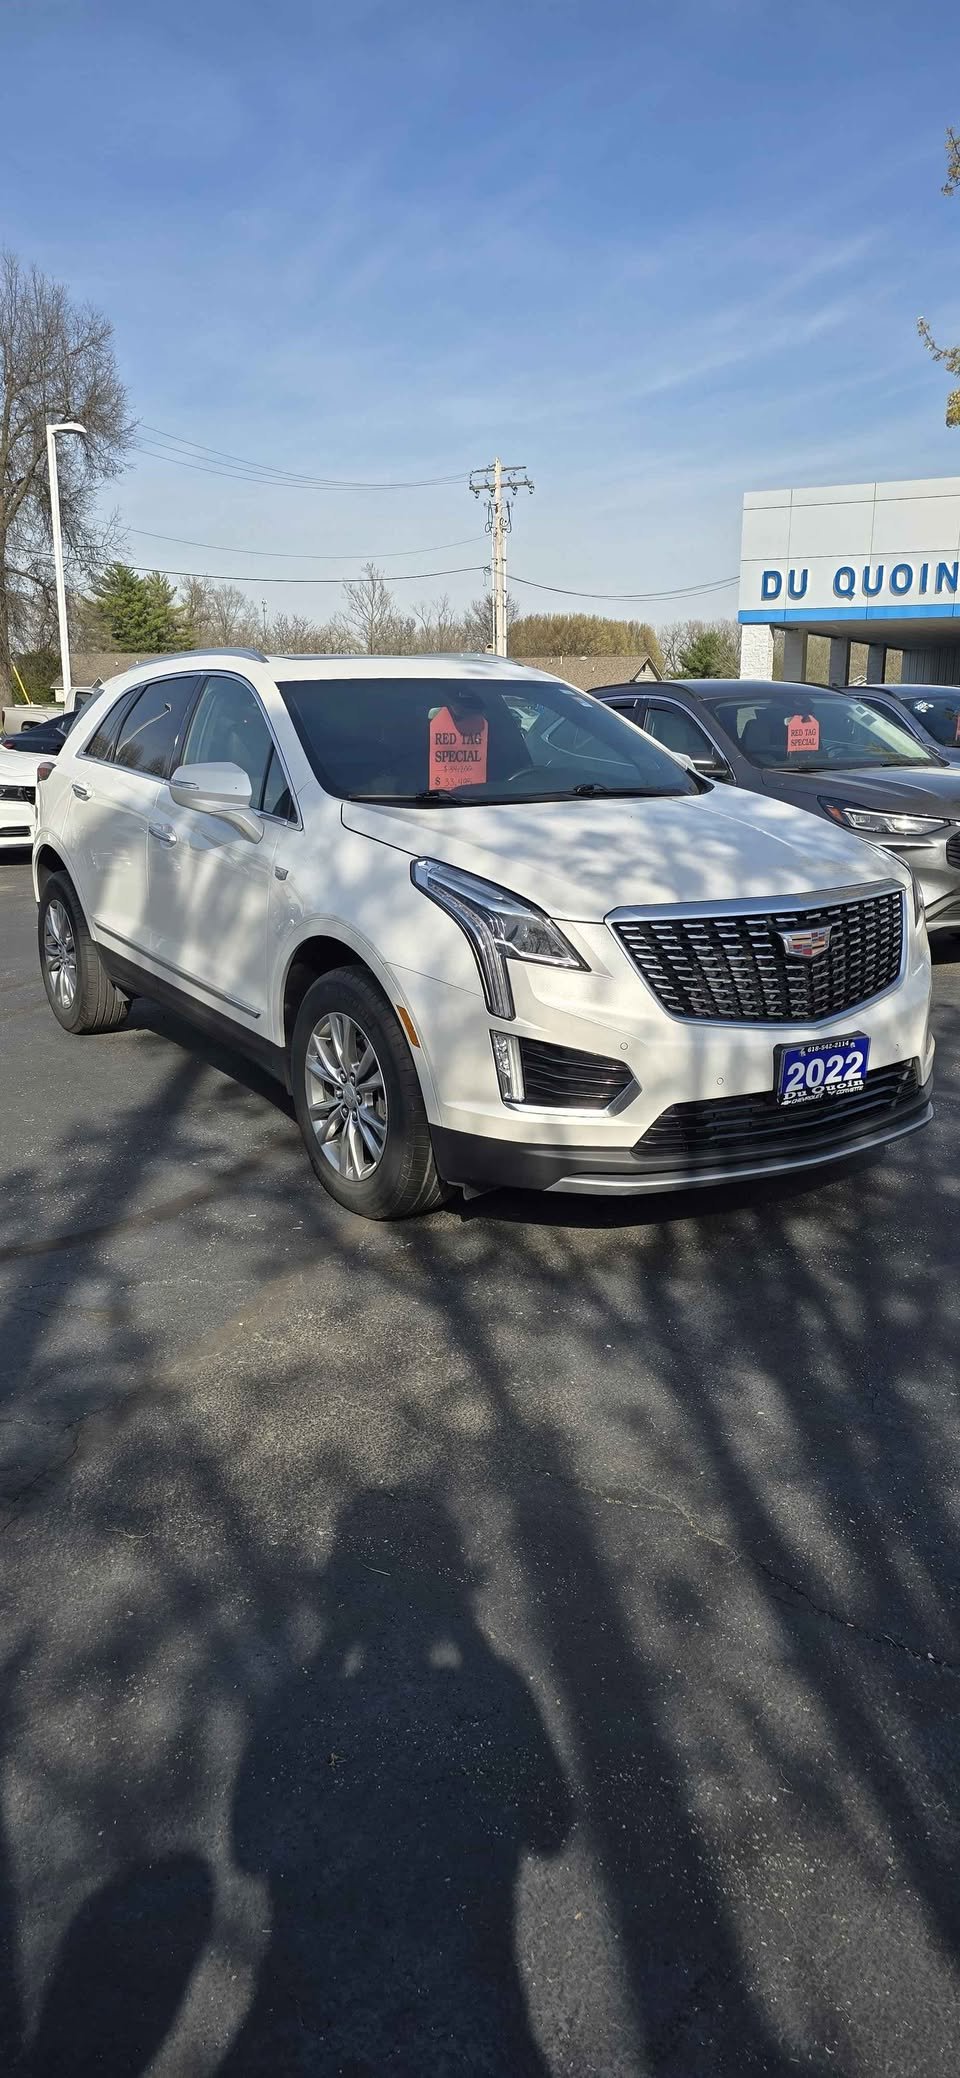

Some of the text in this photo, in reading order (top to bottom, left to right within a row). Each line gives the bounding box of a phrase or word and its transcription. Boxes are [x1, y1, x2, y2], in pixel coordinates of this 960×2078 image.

[761, 562, 959, 601] DU QUOIN
[435, 732, 482, 745] RED TAG
[791, 729, 803, 737] RED
[435, 750, 481, 763] SPECIAL
[807, 1040, 849, 1053] 618-542-2114
[785, 1051, 864, 1092] 2022
[783, 1080, 865, 1101] Du Quoin
[791, 1093, 825, 1104] CHEVROLET
